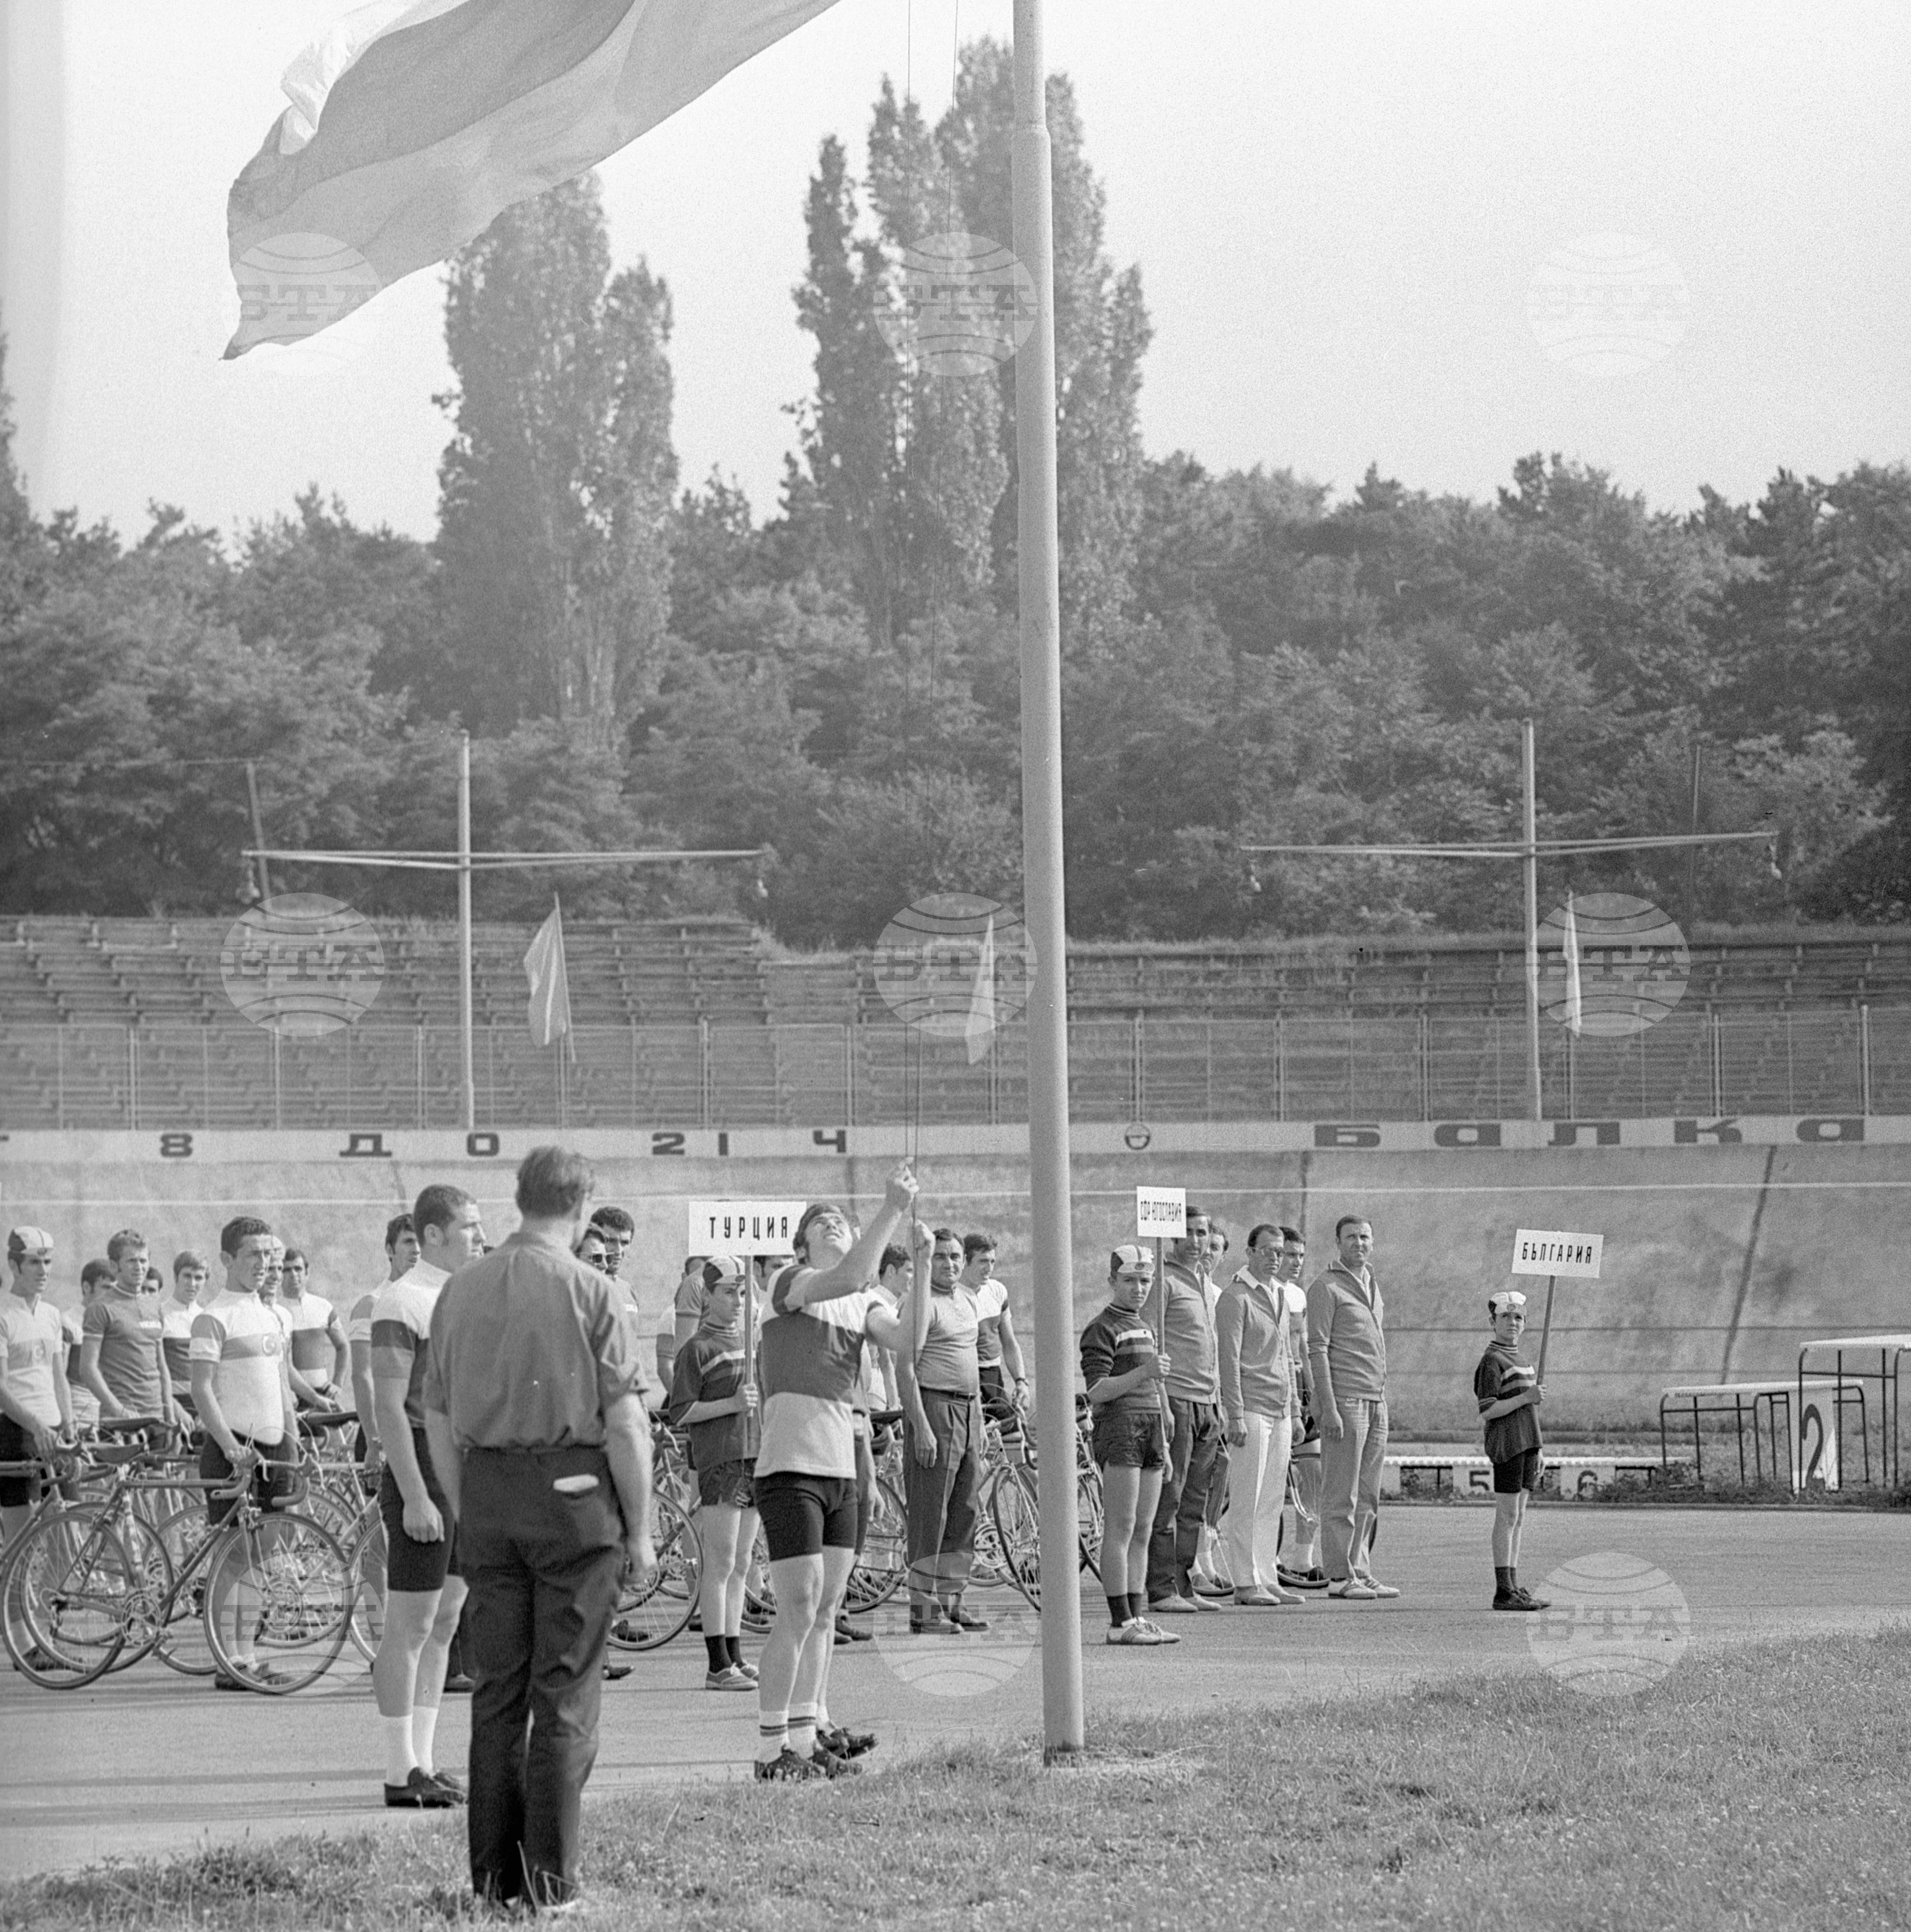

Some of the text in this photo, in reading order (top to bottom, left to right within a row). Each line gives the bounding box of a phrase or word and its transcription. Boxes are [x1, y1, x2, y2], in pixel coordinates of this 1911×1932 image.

[160, 1133, 193, 1158] 8
[709, 1217, 788, 1240] ТУРЦИЯ
[1522, 1242, 1592, 1264] БЪЛГАРИЯ
[1800, 1404, 1825, 1488] 2
[1469, 1470, 1490, 1492] 5
